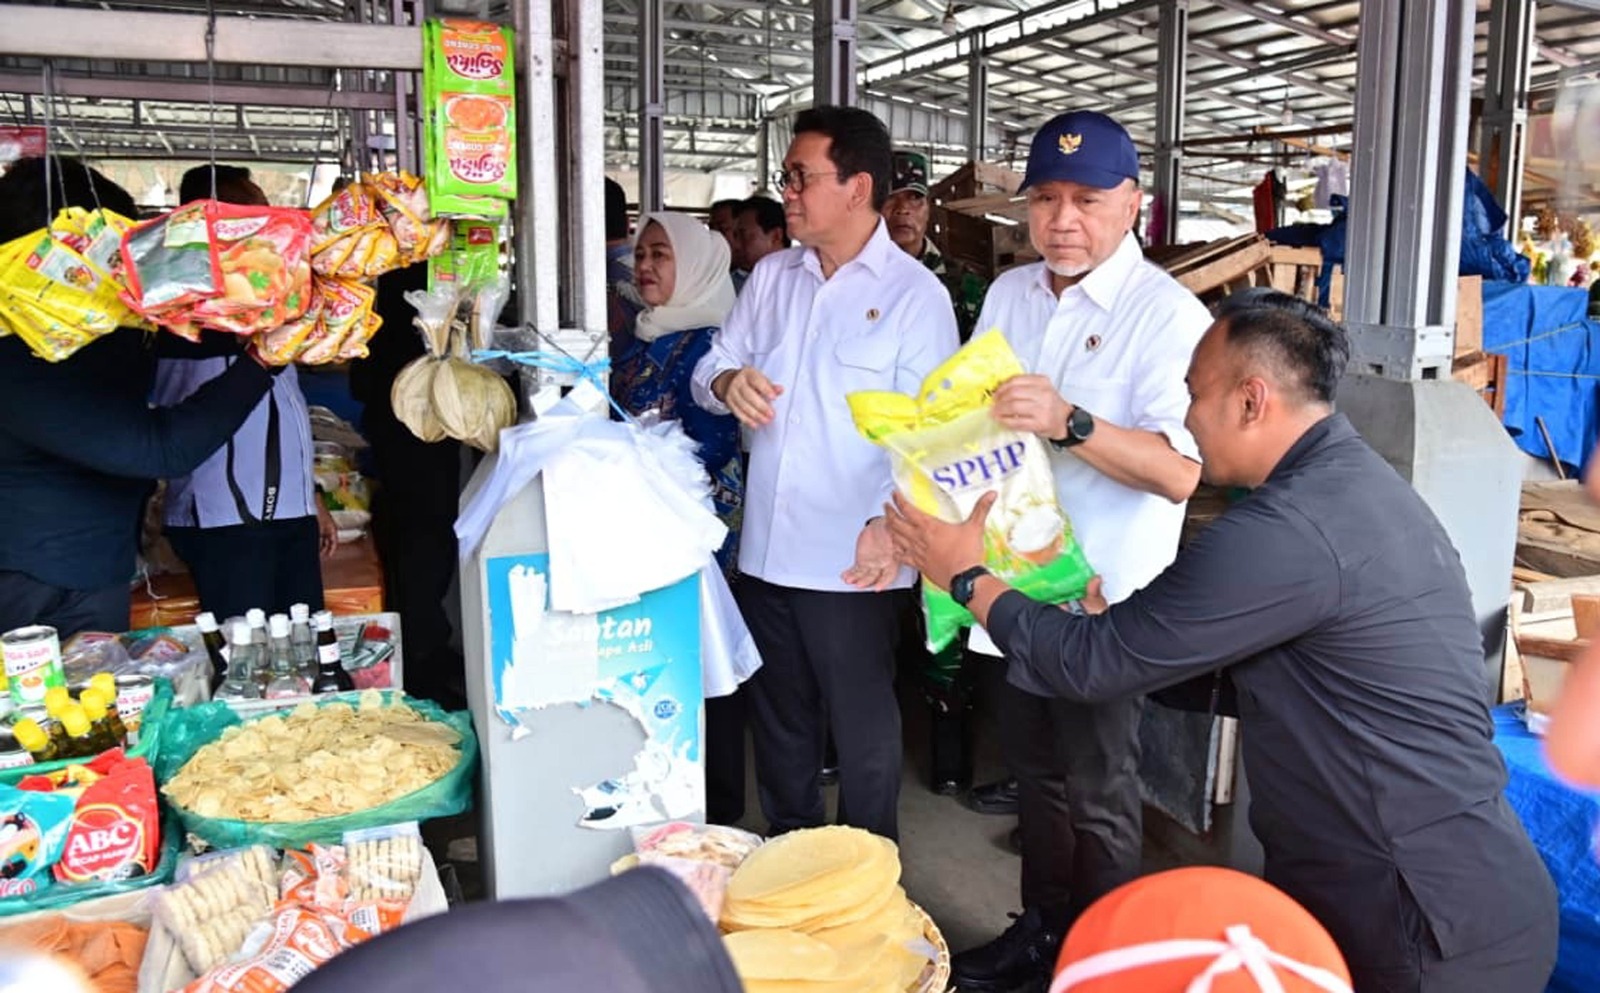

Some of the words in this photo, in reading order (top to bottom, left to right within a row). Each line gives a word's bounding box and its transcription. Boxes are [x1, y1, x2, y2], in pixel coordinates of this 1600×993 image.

[446, 52, 504, 76] Sajiku
[450, 153, 506, 178] Sajiku
[932, 440, 1026, 488] SPHP
[627, 639, 654, 653] Asli
[68, 825, 130, 857] ABC
